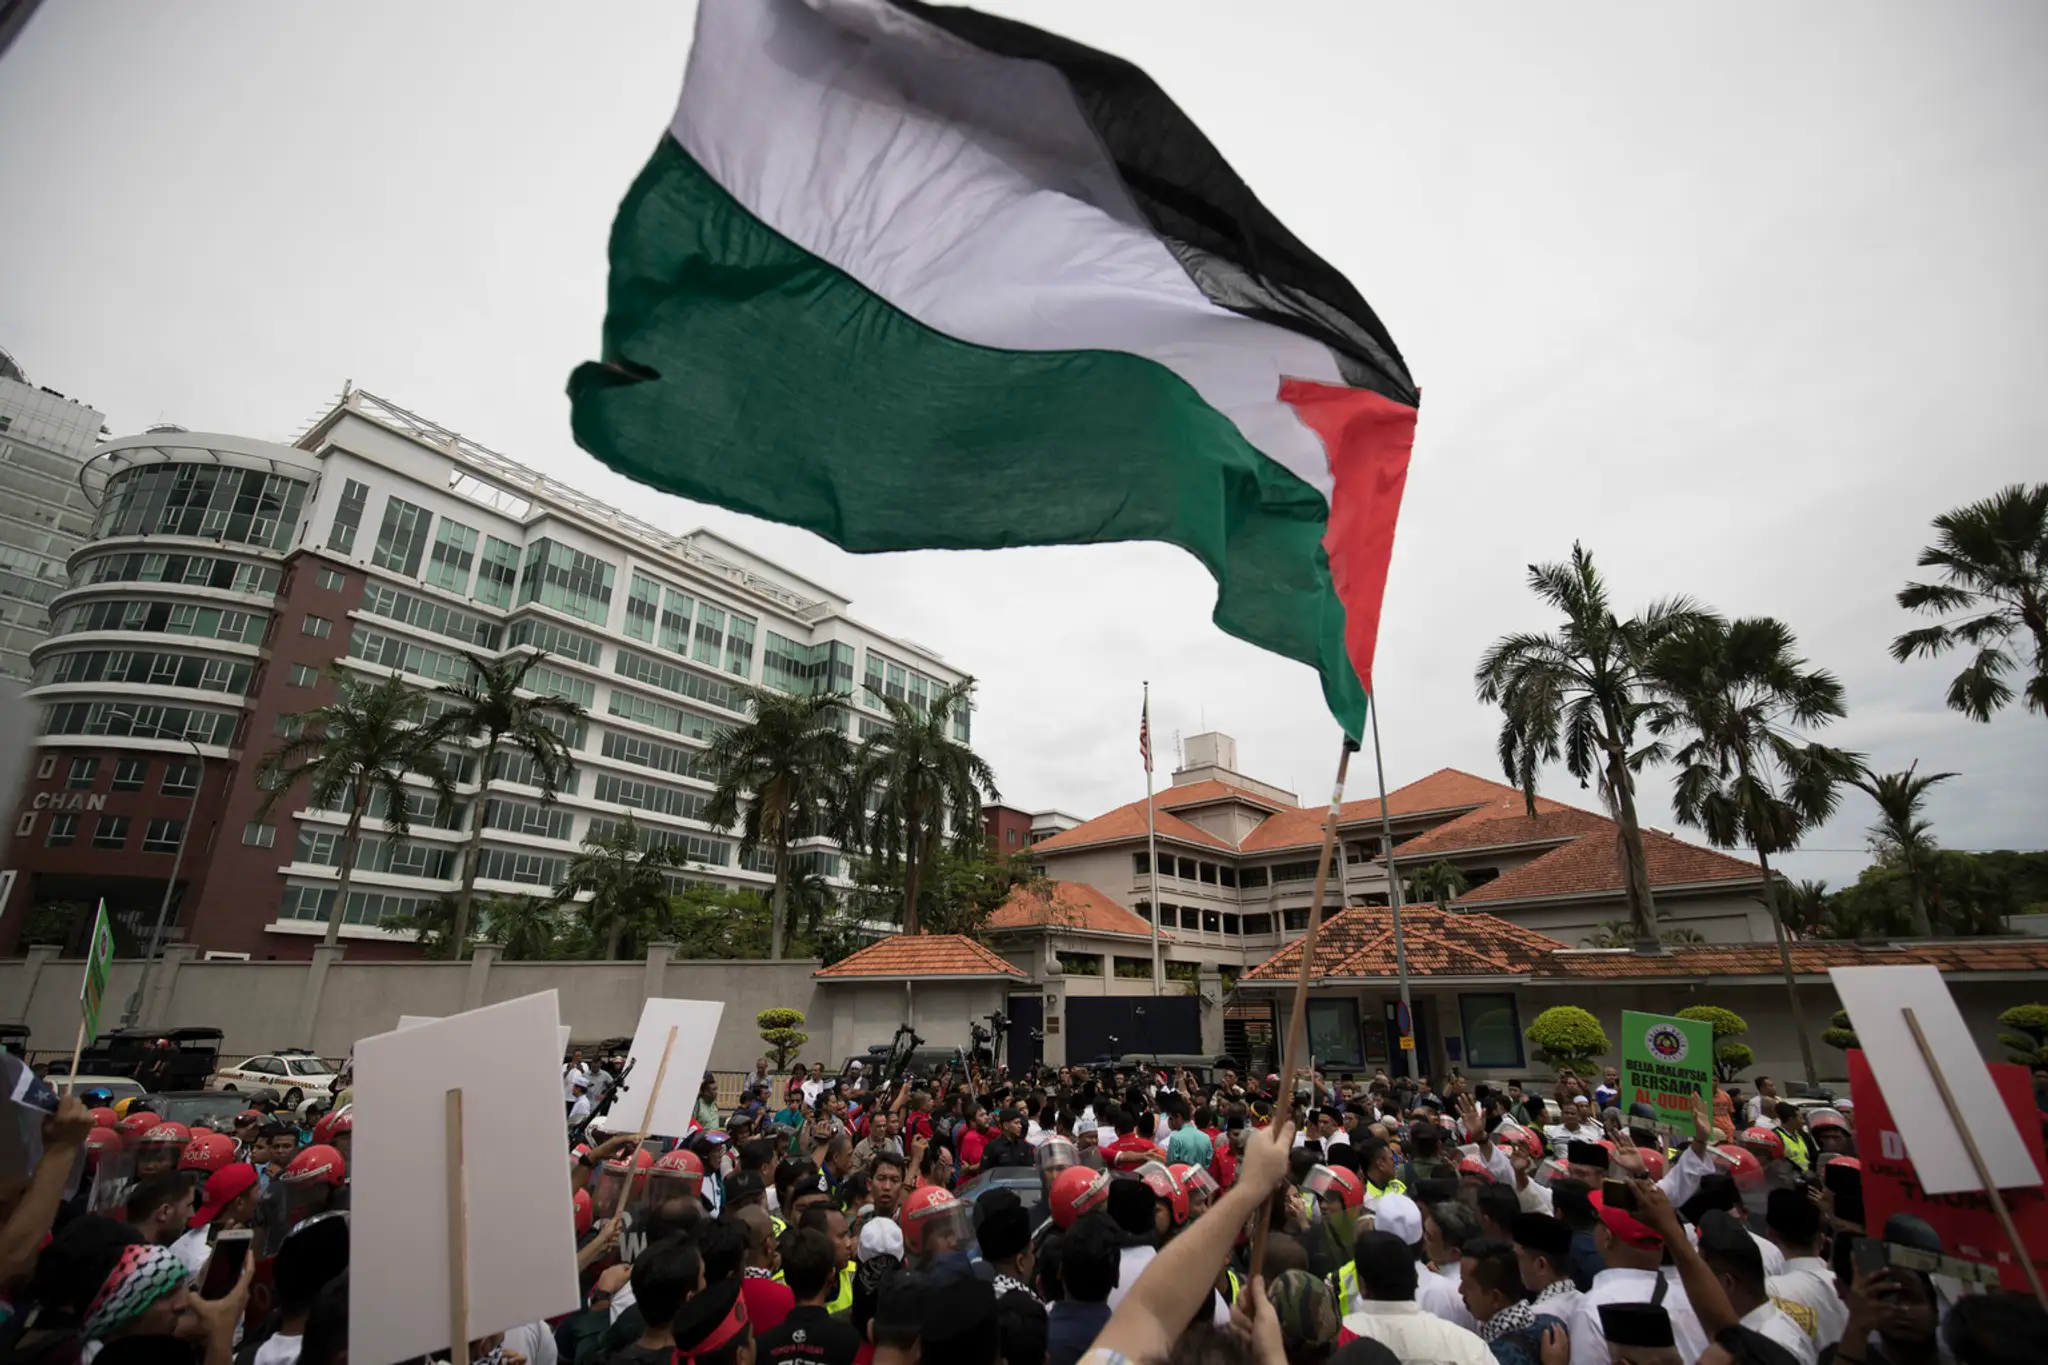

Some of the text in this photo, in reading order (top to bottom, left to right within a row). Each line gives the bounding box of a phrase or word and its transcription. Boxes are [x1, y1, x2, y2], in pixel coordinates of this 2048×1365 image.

[33, 792, 107, 812] CHAN
[1626, 1059, 1707, 1082] BELIA MALAYSIA
[1631, 1072, 1701, 1097] BERSAMA
[1636, 1088, 1691, 1111] AL-QUD
